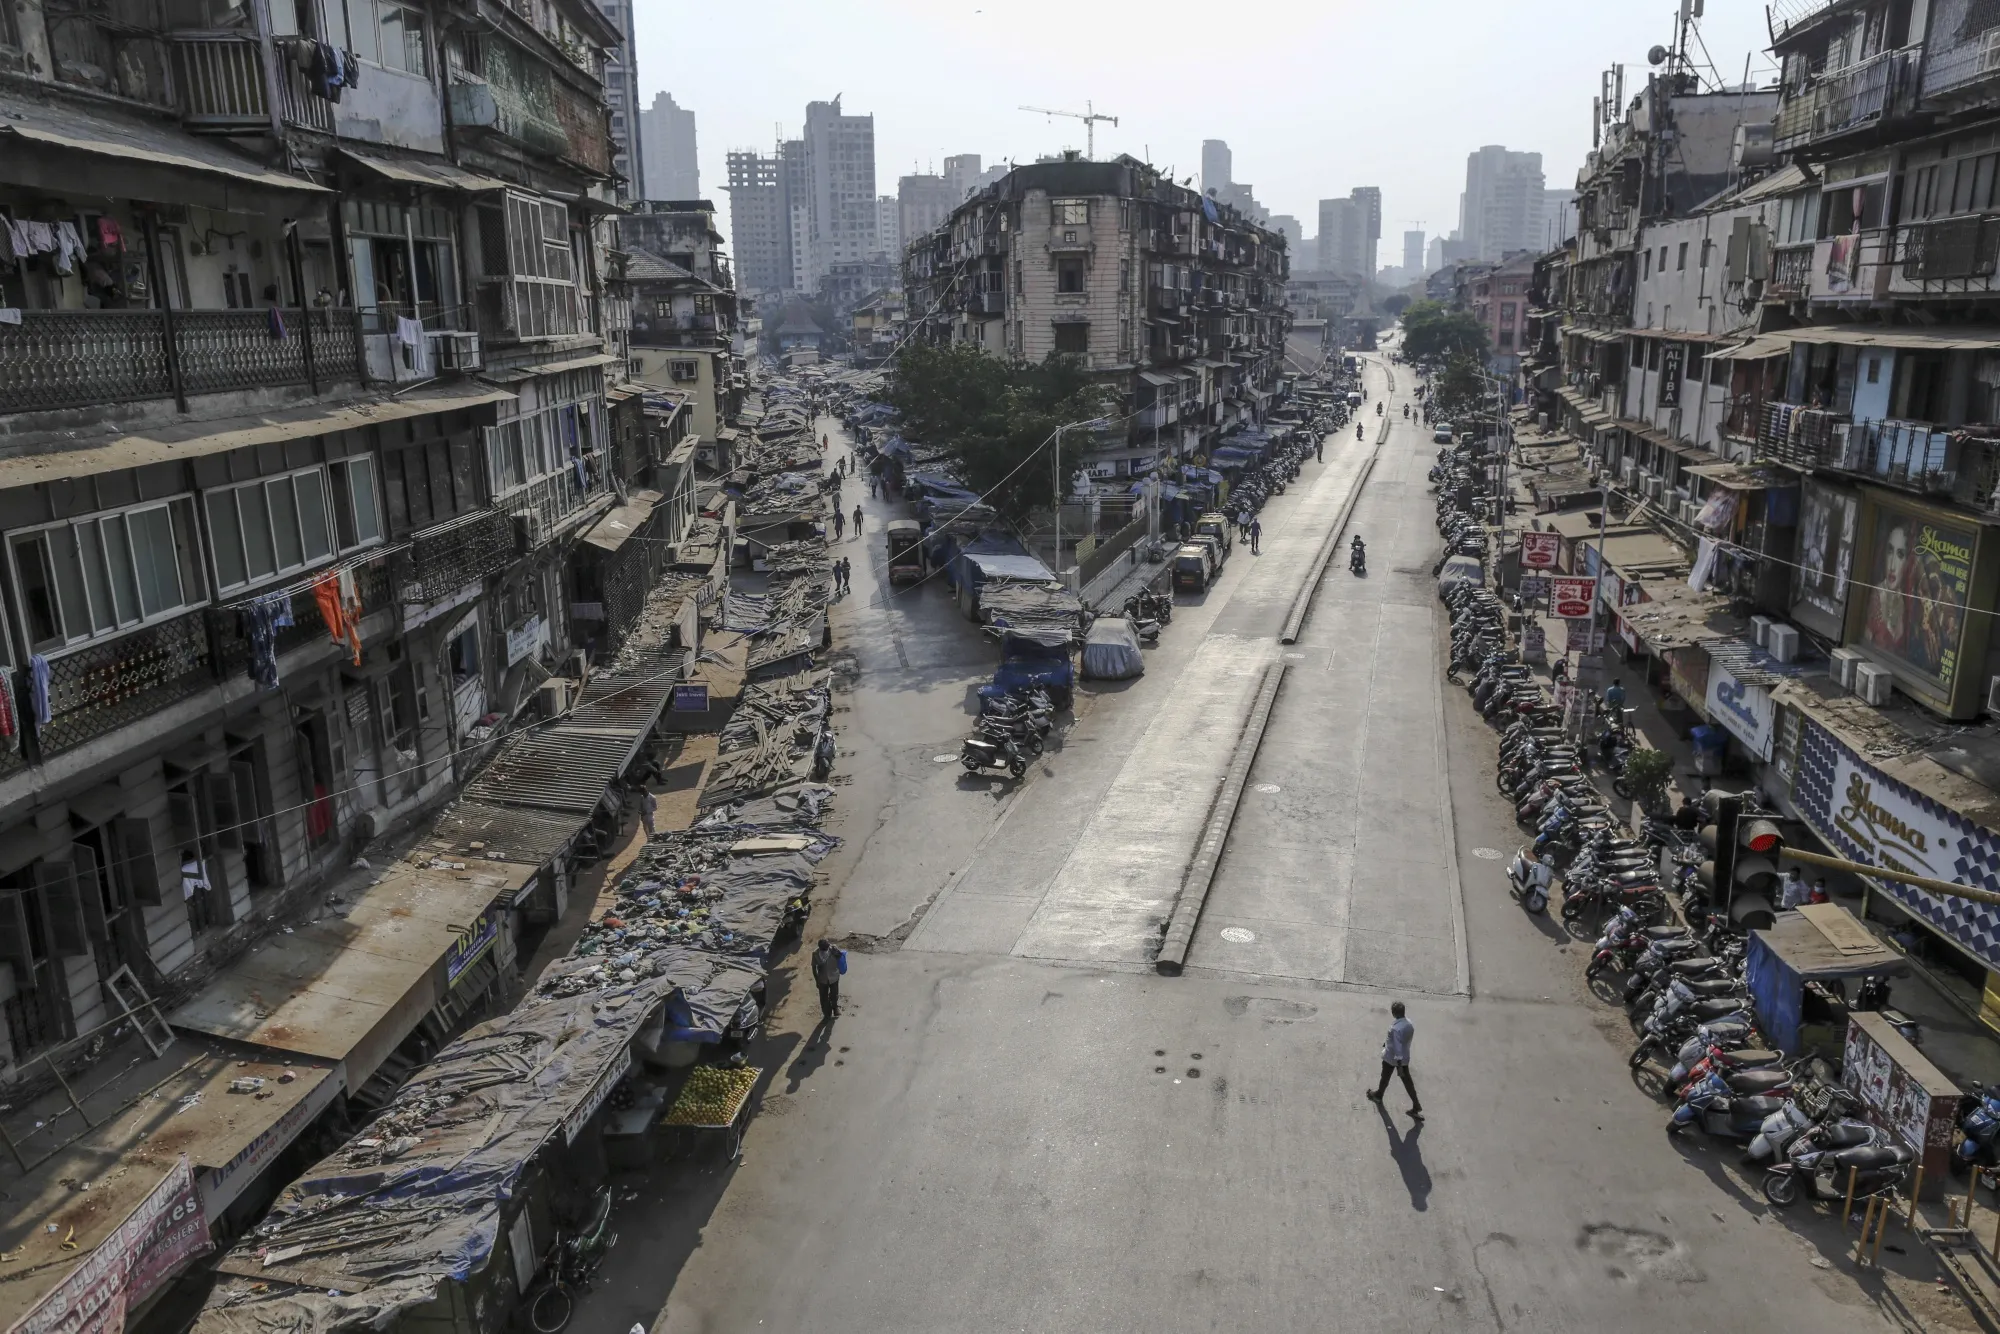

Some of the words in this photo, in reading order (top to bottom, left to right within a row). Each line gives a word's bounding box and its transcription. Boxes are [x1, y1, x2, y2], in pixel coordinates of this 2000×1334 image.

[1915, 526, 1970, 561] Shama
[1841, 772, 1928, 853] Shama
[70, 1227, 125, 1292] LUNGI
